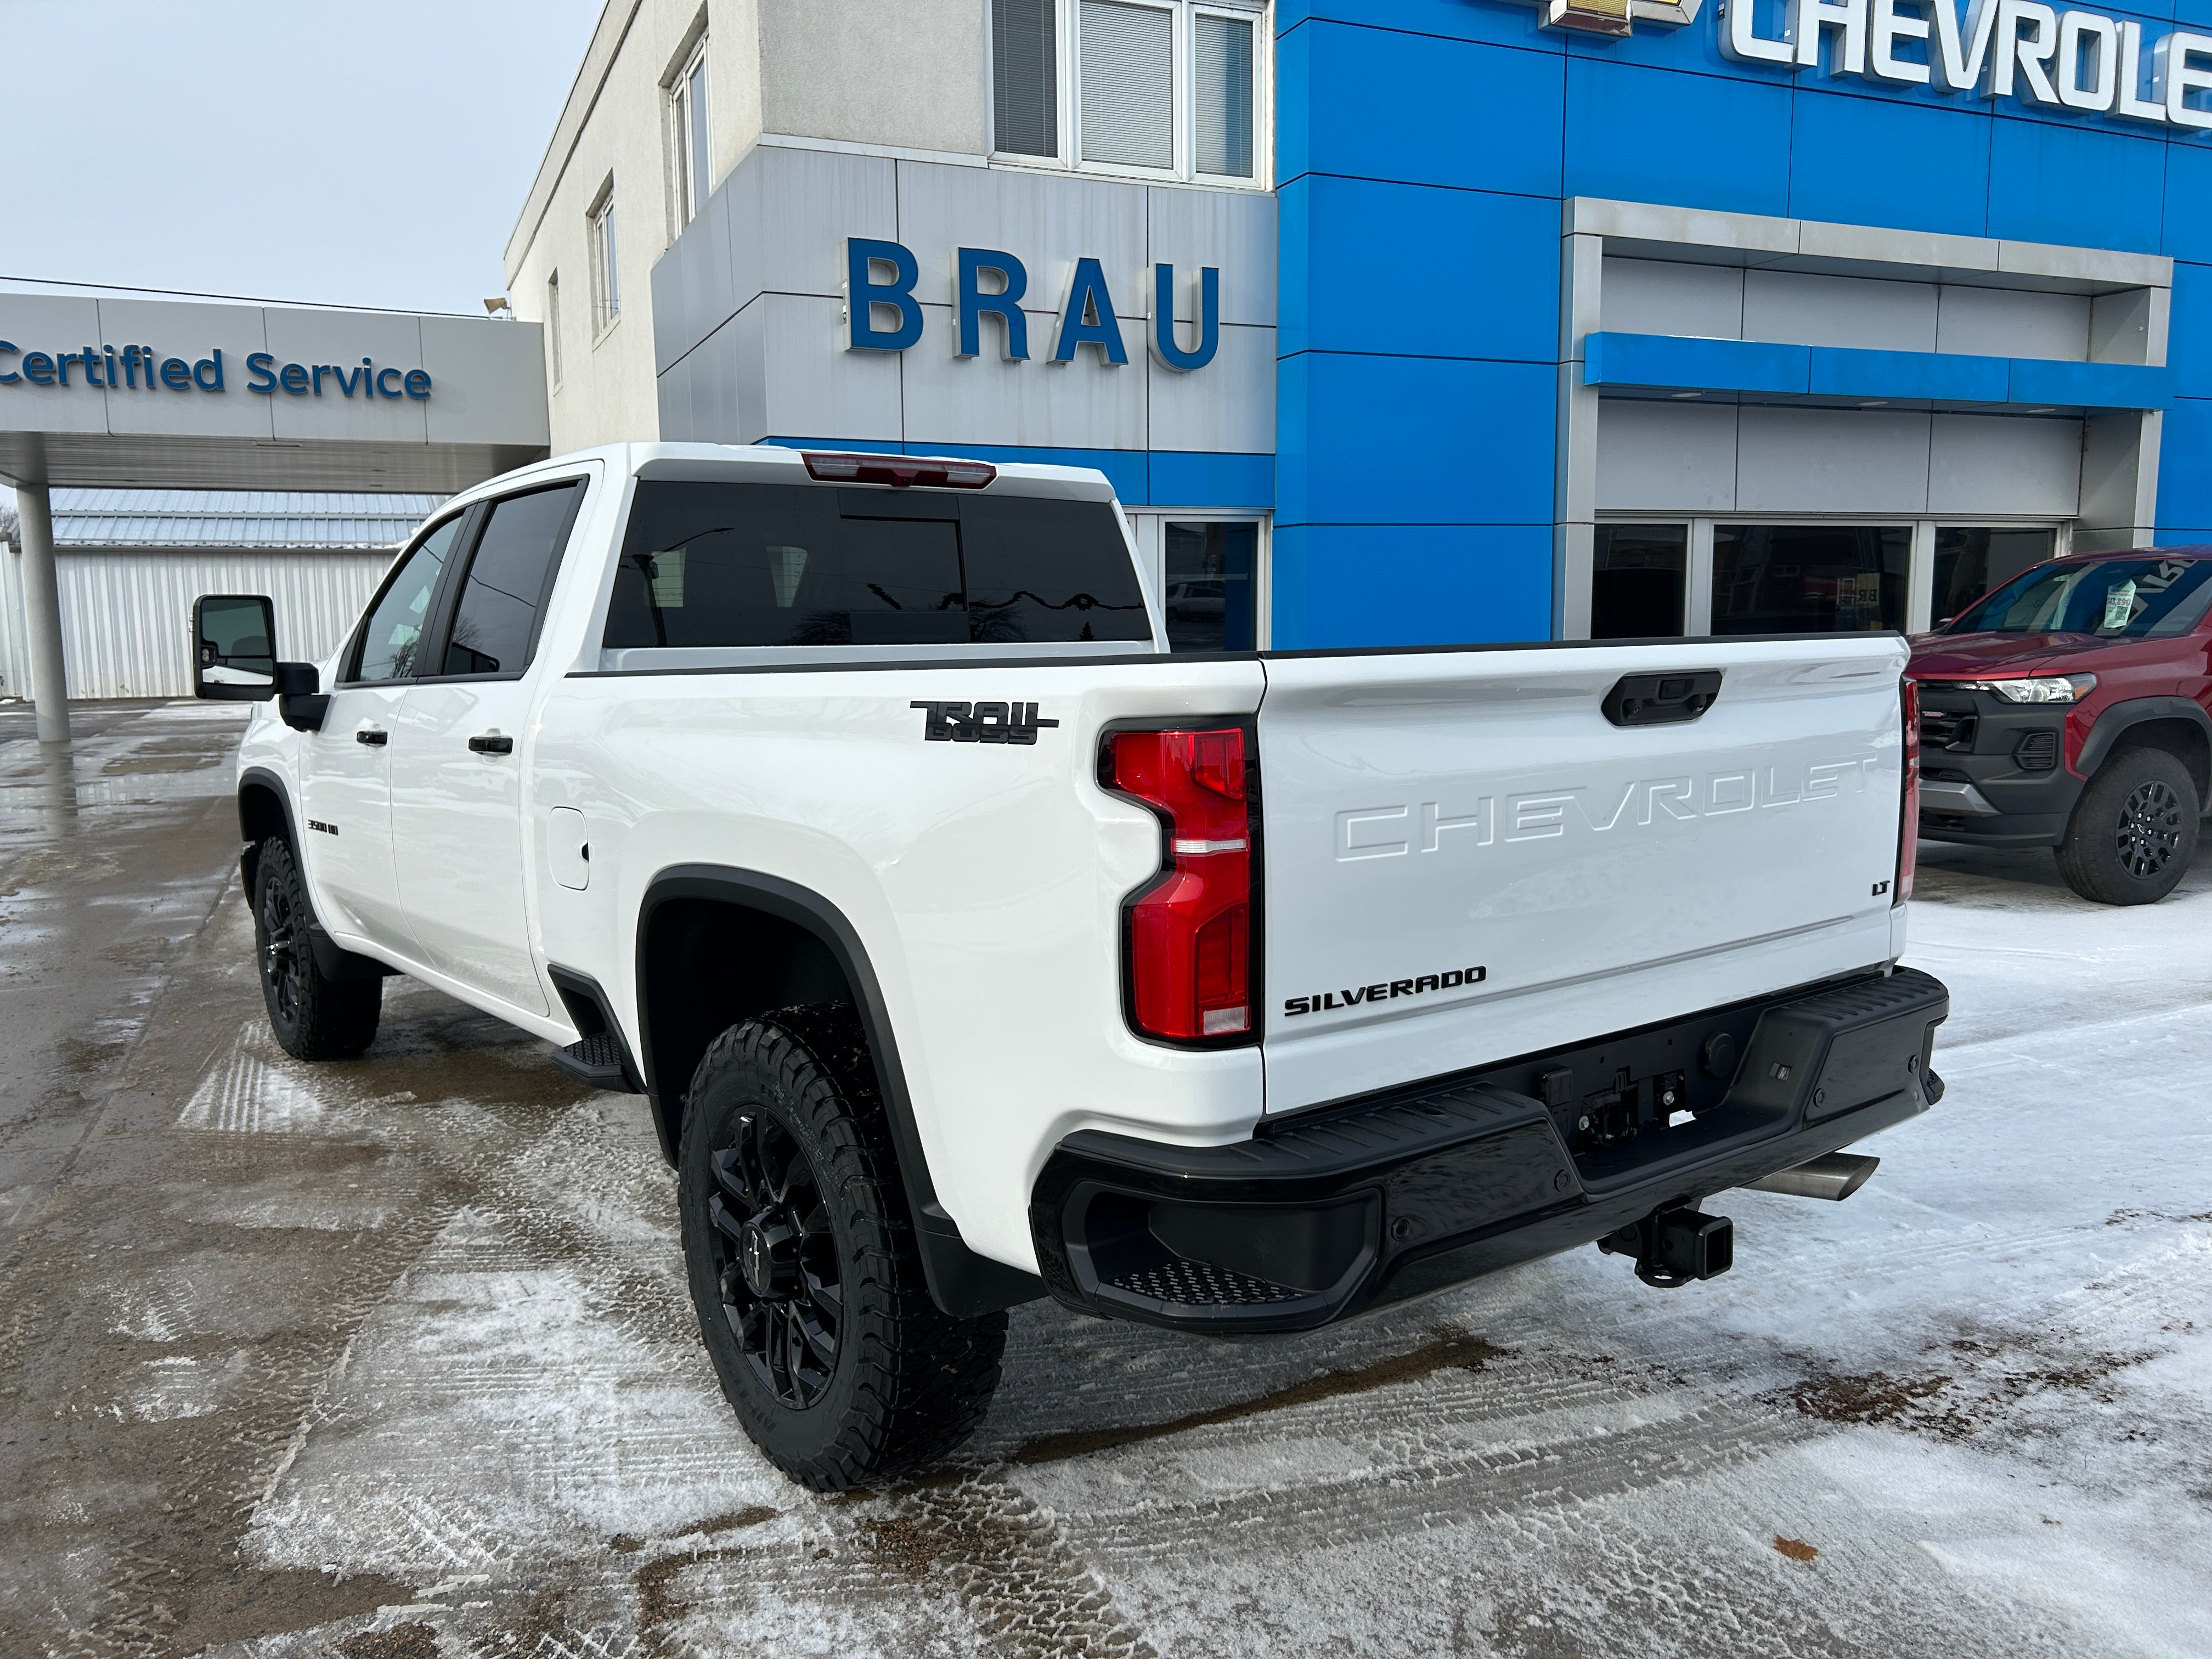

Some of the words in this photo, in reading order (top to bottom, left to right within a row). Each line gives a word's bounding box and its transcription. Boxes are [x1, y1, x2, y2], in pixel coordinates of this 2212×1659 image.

[844, 237, 1220, 372] BRAU
[0, 340, 225, 392] Certified
[246, 352, 432, 400] Service
[308, 819, 328, 833] 3500
[1335, 753, 1877, 862] CHEVROLET
[1872, 880, 1891, 896] LT
[1284, 966, 1486, 1017] SILVERADO
